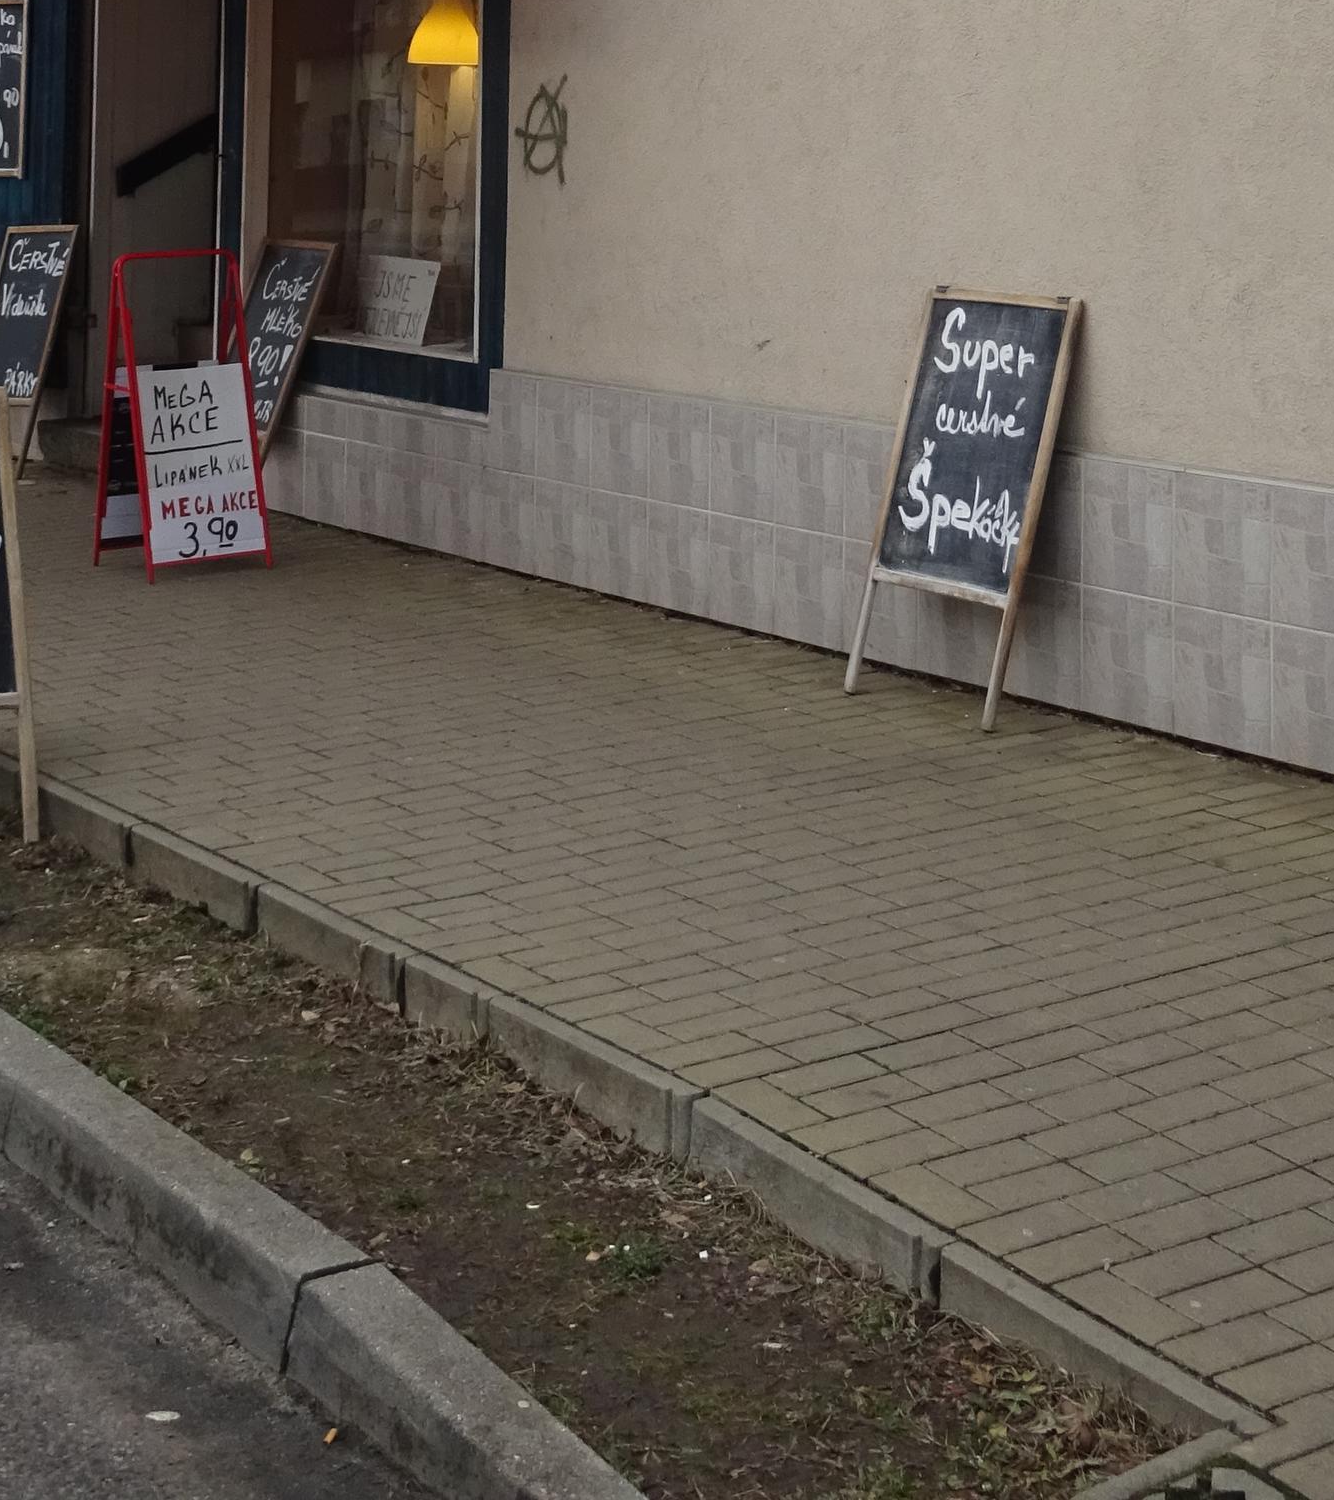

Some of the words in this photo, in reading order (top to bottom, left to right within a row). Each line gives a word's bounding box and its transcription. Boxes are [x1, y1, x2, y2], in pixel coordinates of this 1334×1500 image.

[933, 306, 1035, 400] Super
[150, 405, 219, 445] AKCE
[161, 494, 215, 520] MEGA
[222, 490, 259, 512] AKCE
